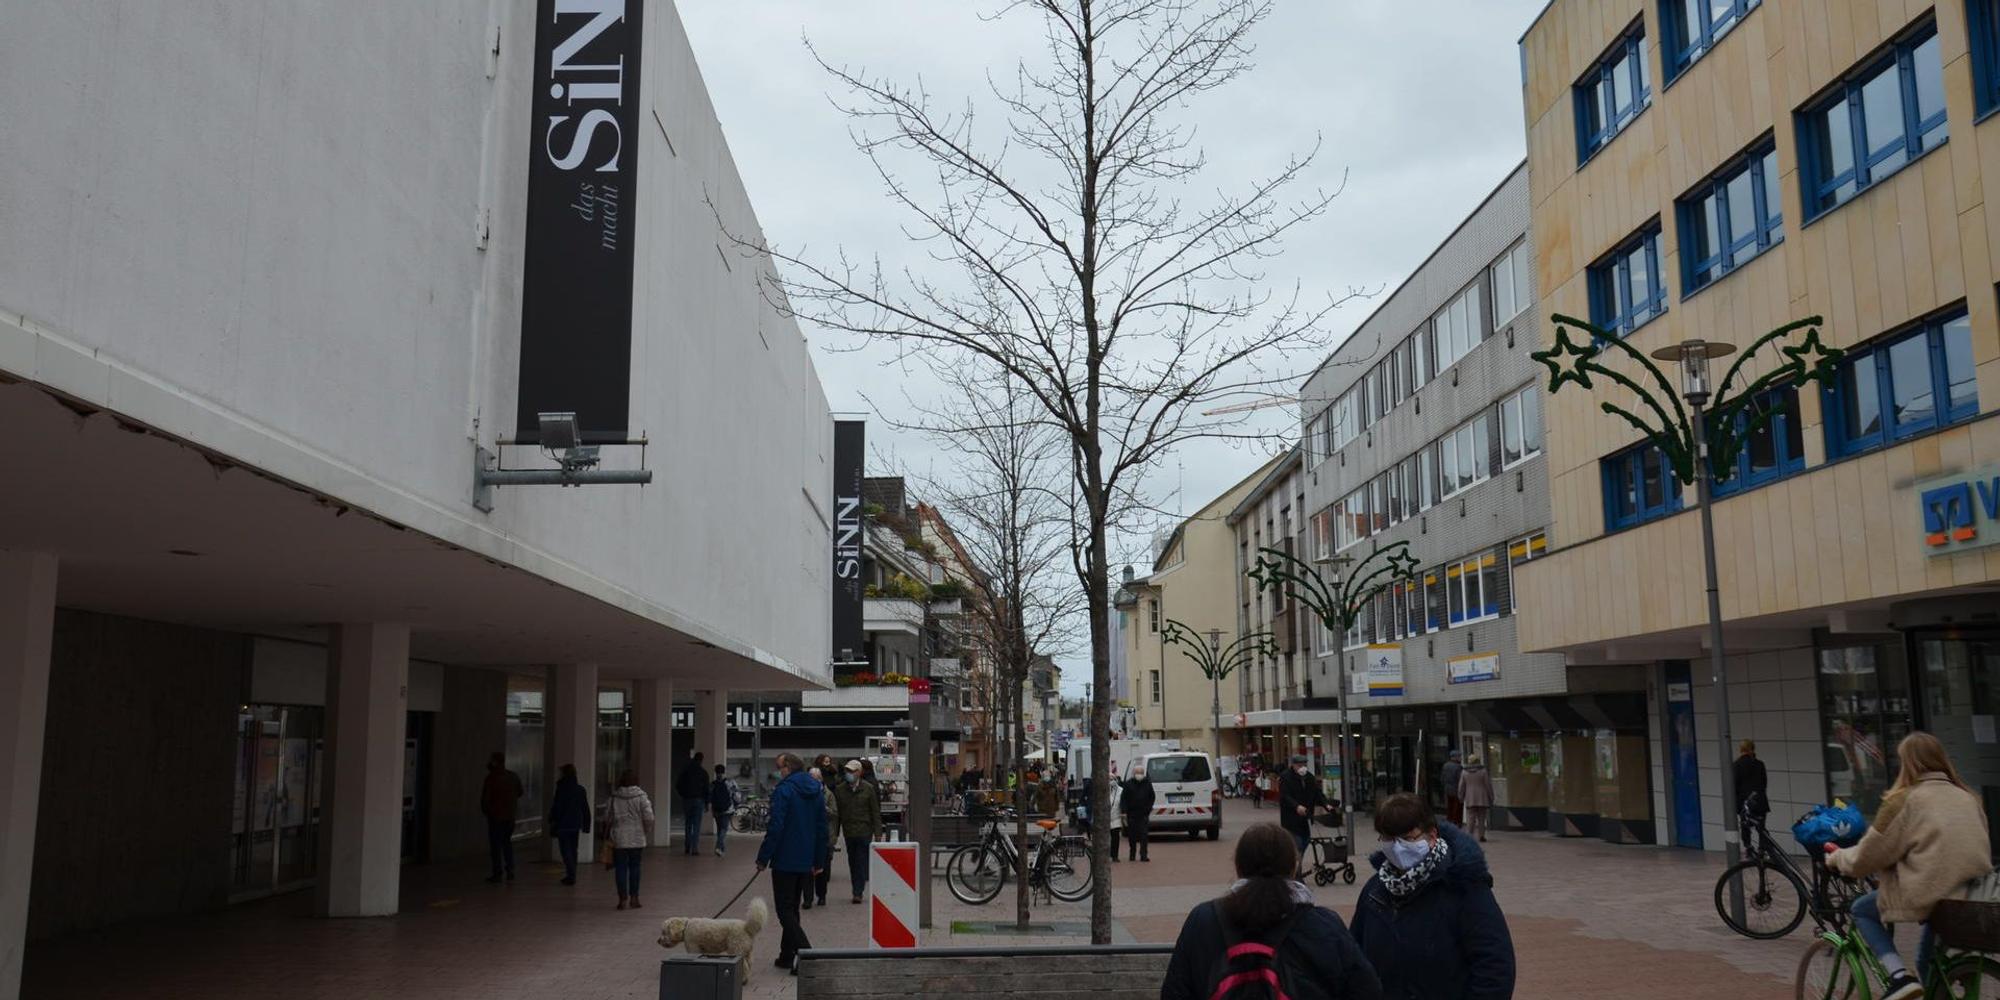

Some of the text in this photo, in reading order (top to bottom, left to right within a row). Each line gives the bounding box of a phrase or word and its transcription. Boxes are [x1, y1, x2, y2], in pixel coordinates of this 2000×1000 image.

[571, 182, 596, 222] das
[596, 185, 620, 250] macht
[836, 494, 860, 580] SiNN
